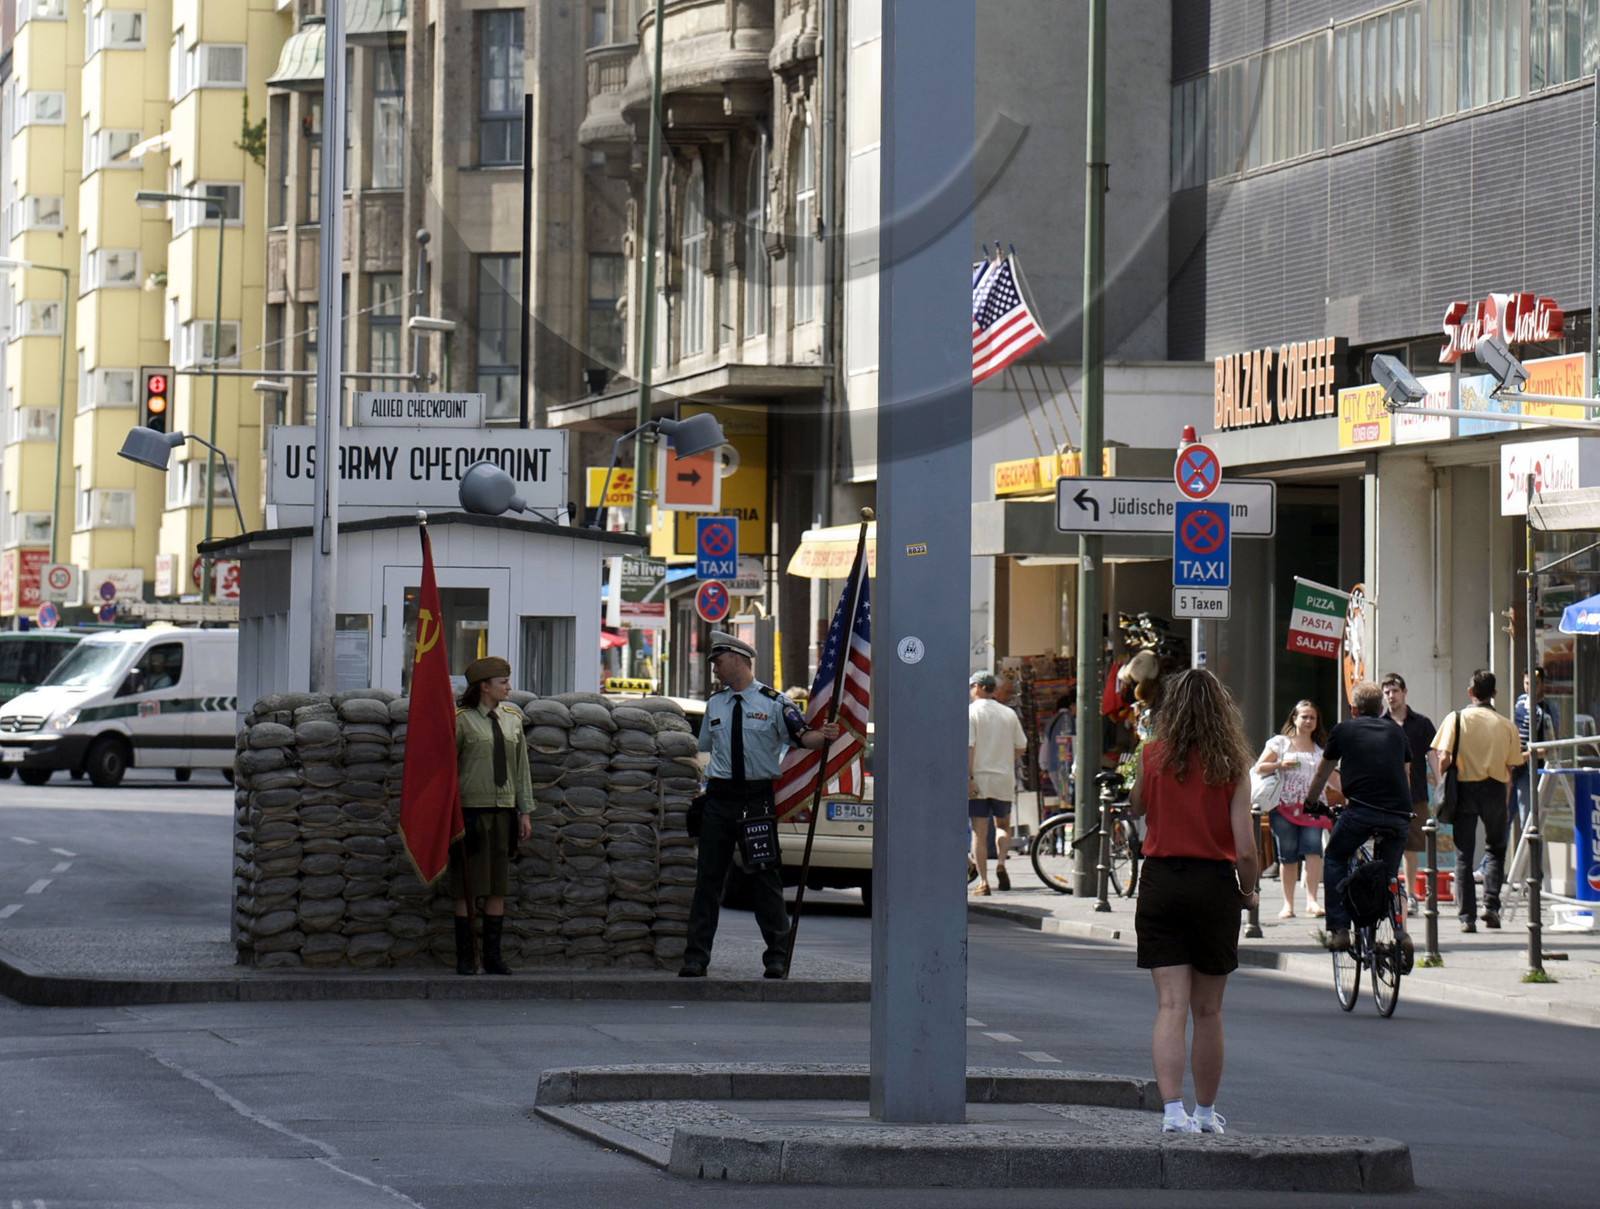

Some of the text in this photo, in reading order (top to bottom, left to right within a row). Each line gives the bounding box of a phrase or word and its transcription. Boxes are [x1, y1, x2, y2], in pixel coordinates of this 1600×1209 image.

[1503, 292, 1552, 344] Charlie
[1214, 337, 1335, 430] BALZAC COFFEE
[371, 398, 468, 419] ALLIED CHECKPOINT
[1109, 497, 1175, 516] Jüdische
[641, 561, 665, 577] live
[701, 561, 734, 574] TAXI
[1180, 561, 1224, 579] TAXI
[1180, 596, 1223, 611] 5 Taxen
[1306, 595, 1336, 611] PIZZA
[1301, 615, 1334, 631] PASTA
[1296, 635, 1335, 653] SALATE
[746, 824, 769, 833] FOTO
